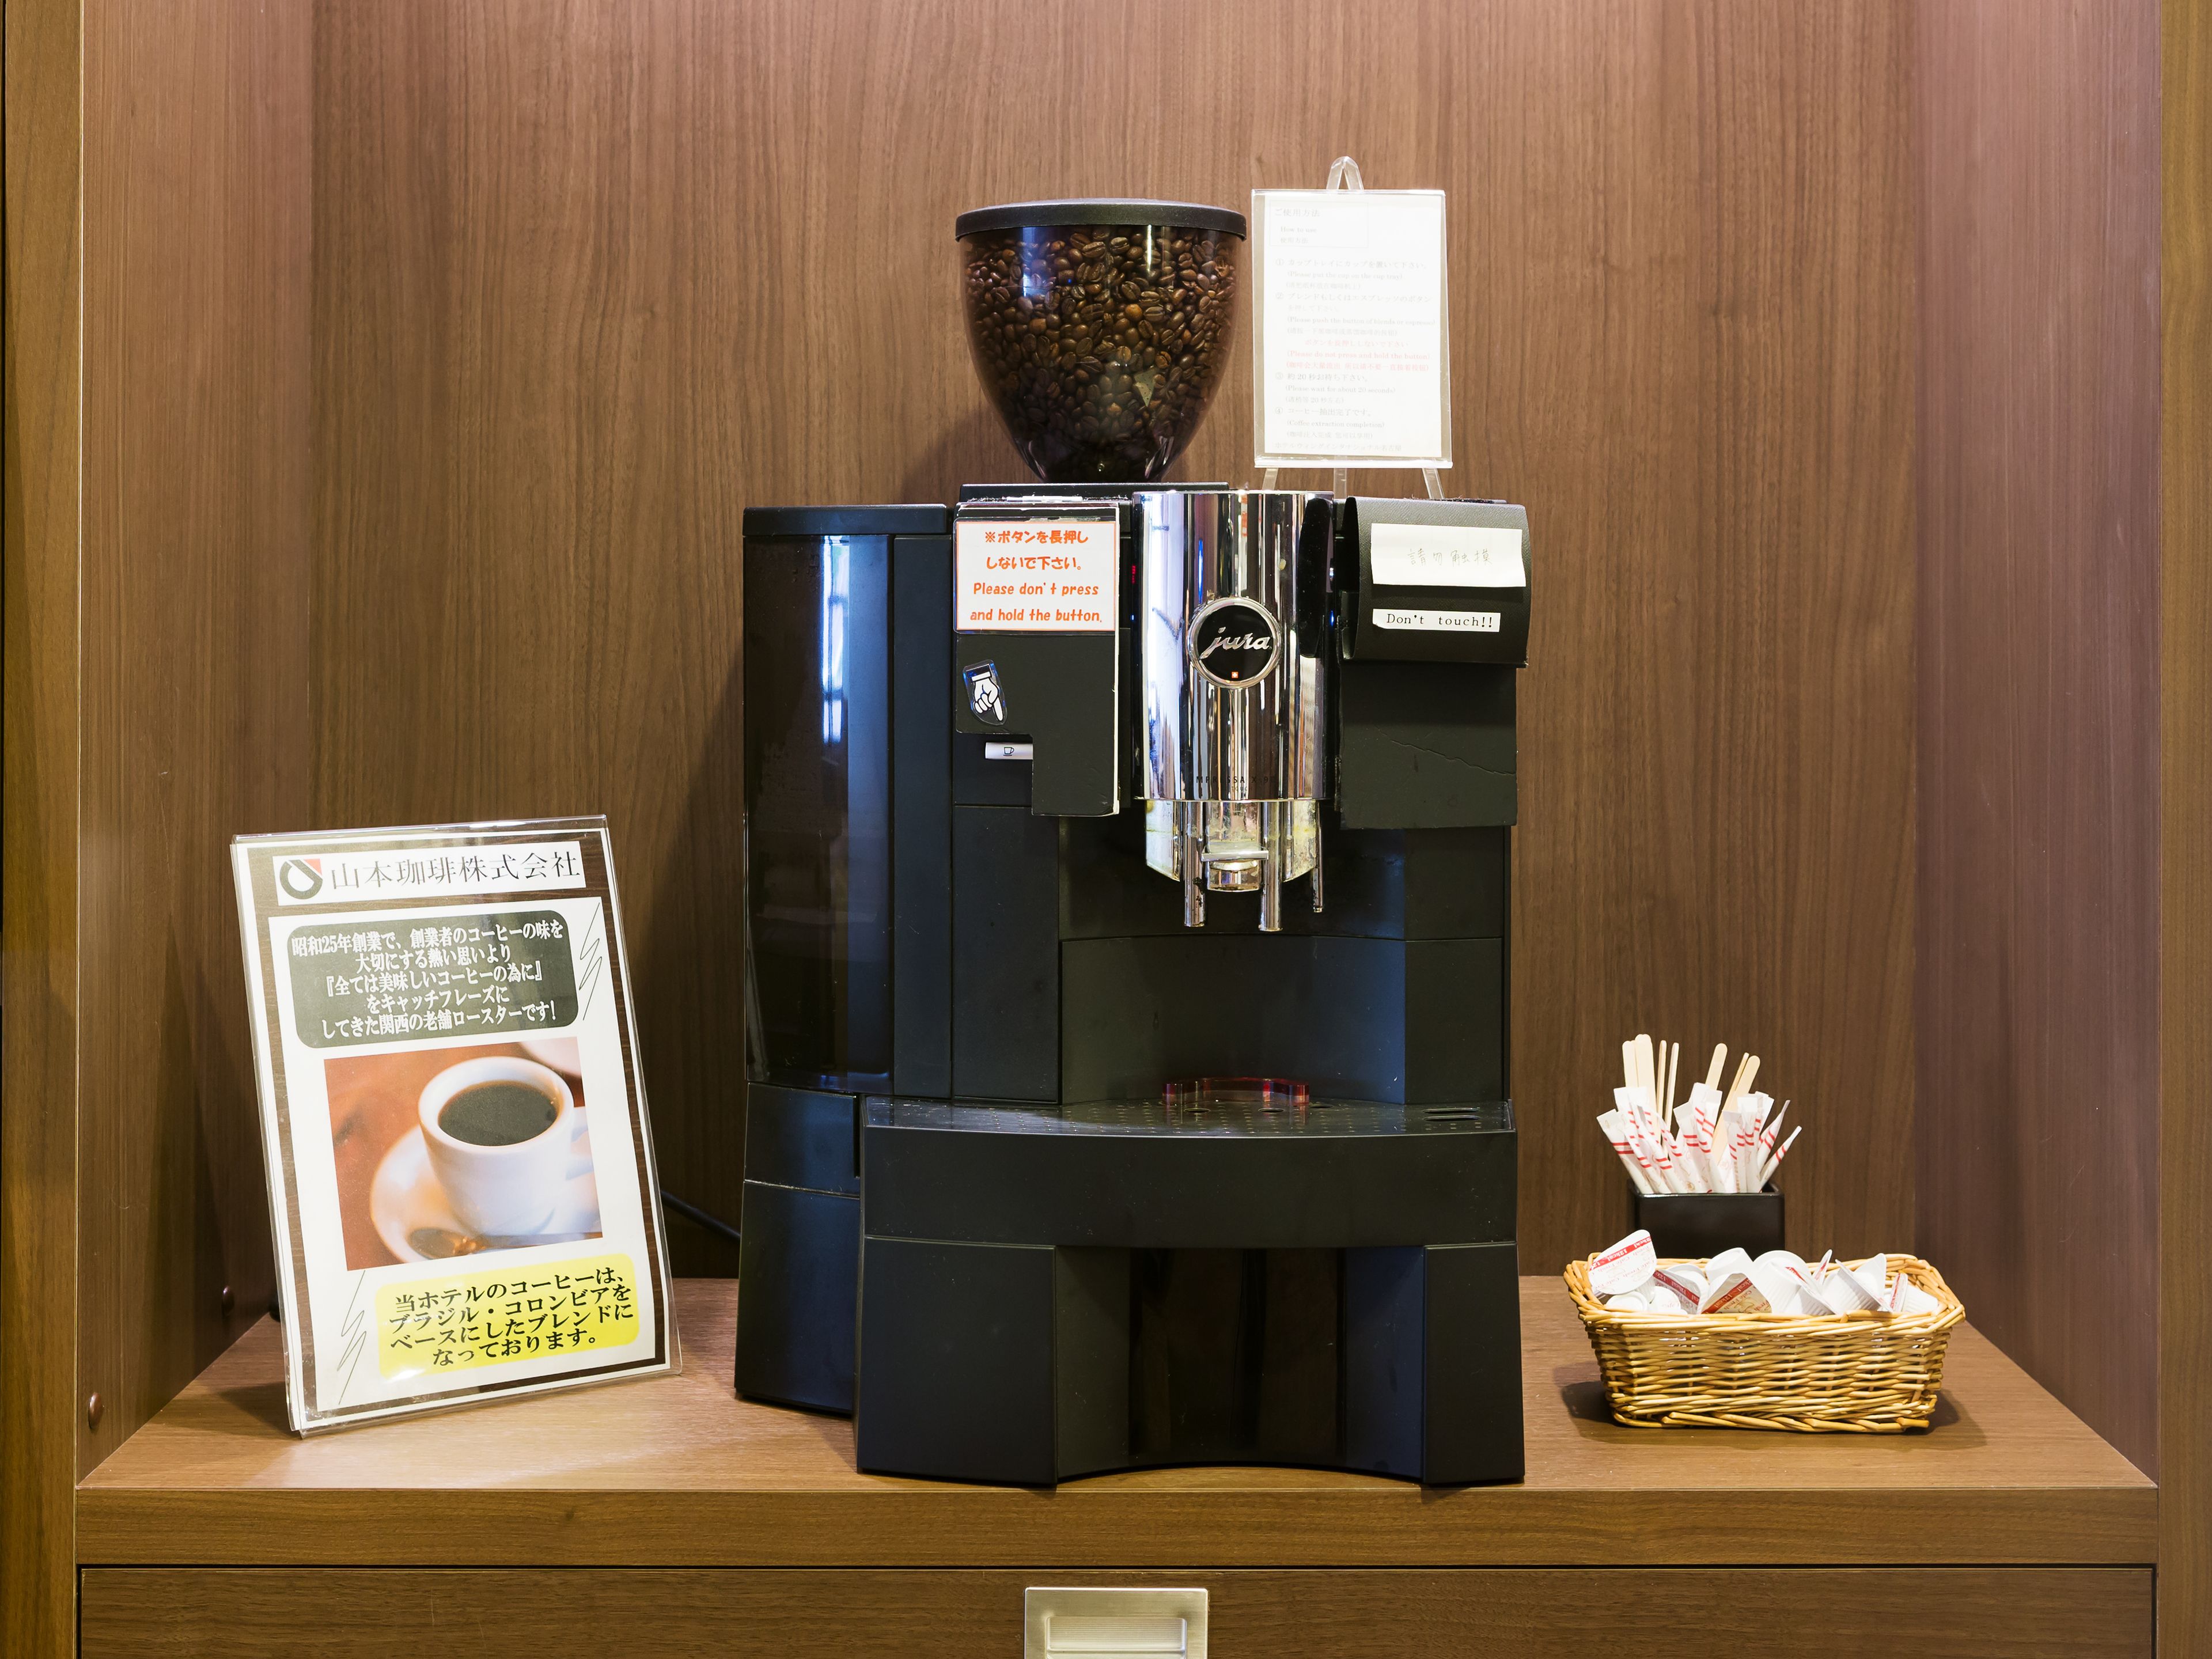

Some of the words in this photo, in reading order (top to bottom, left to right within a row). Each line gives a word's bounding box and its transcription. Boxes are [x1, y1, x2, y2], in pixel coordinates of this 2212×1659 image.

[1275, 208, 1320, 217] ご使用方法
[1288, 408, 1371, 416] コーヒー抽出完了です。
[986, 556, 1082, 571] しないで下さい。
[974, 582, 1014, 595] Please
[1062, 584, 1099, 597] press
[970, 609, 993, 622] and
[998, 609, 1024, 622] hold
[1029, 609, 1051, 622] the
[1055, 609, 1102, 623] button.
[1387, 613, 1424, 625] Don't
[1438, 616, 1493, 628] touch!!
[1199, 627, 1271, 660] jura
[331, 851, 581, 890] 山本珈琲株式会社
[355, 944, 511, 974] 大切にする熱い思いより
[325, 960, 543, 998] 『全ては美味しいコーヒーの為に』
[367, 985, 510, 1014] をキャッチフレーズに
[1607, 1248, 1627, 1262] 12kcal
[396, 1267, 623, 1313] 当ホテルのコーヒーは、
[389, 1285, 632, 1334] ブラジル・コロンビアを
[390, 1304, 634, 1350] ベースにしたブレンドに
[433, 1329, 596, 1366] なっております。
